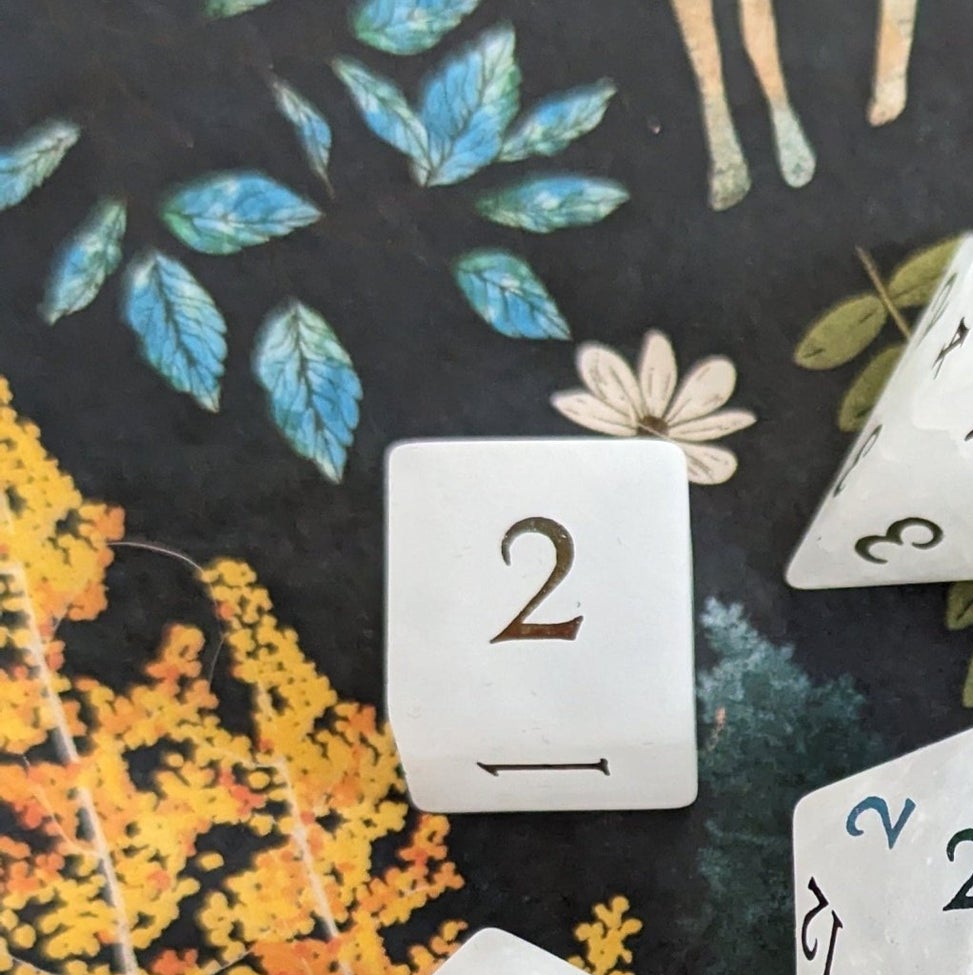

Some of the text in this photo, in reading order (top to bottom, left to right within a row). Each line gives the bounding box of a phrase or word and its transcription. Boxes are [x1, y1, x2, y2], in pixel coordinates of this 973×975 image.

[855, 517, 943, 564] 3
[489, 516, 583, 643] 2
[477, 758, 610, 776] 1
[846, 796, 916, 850] 2
